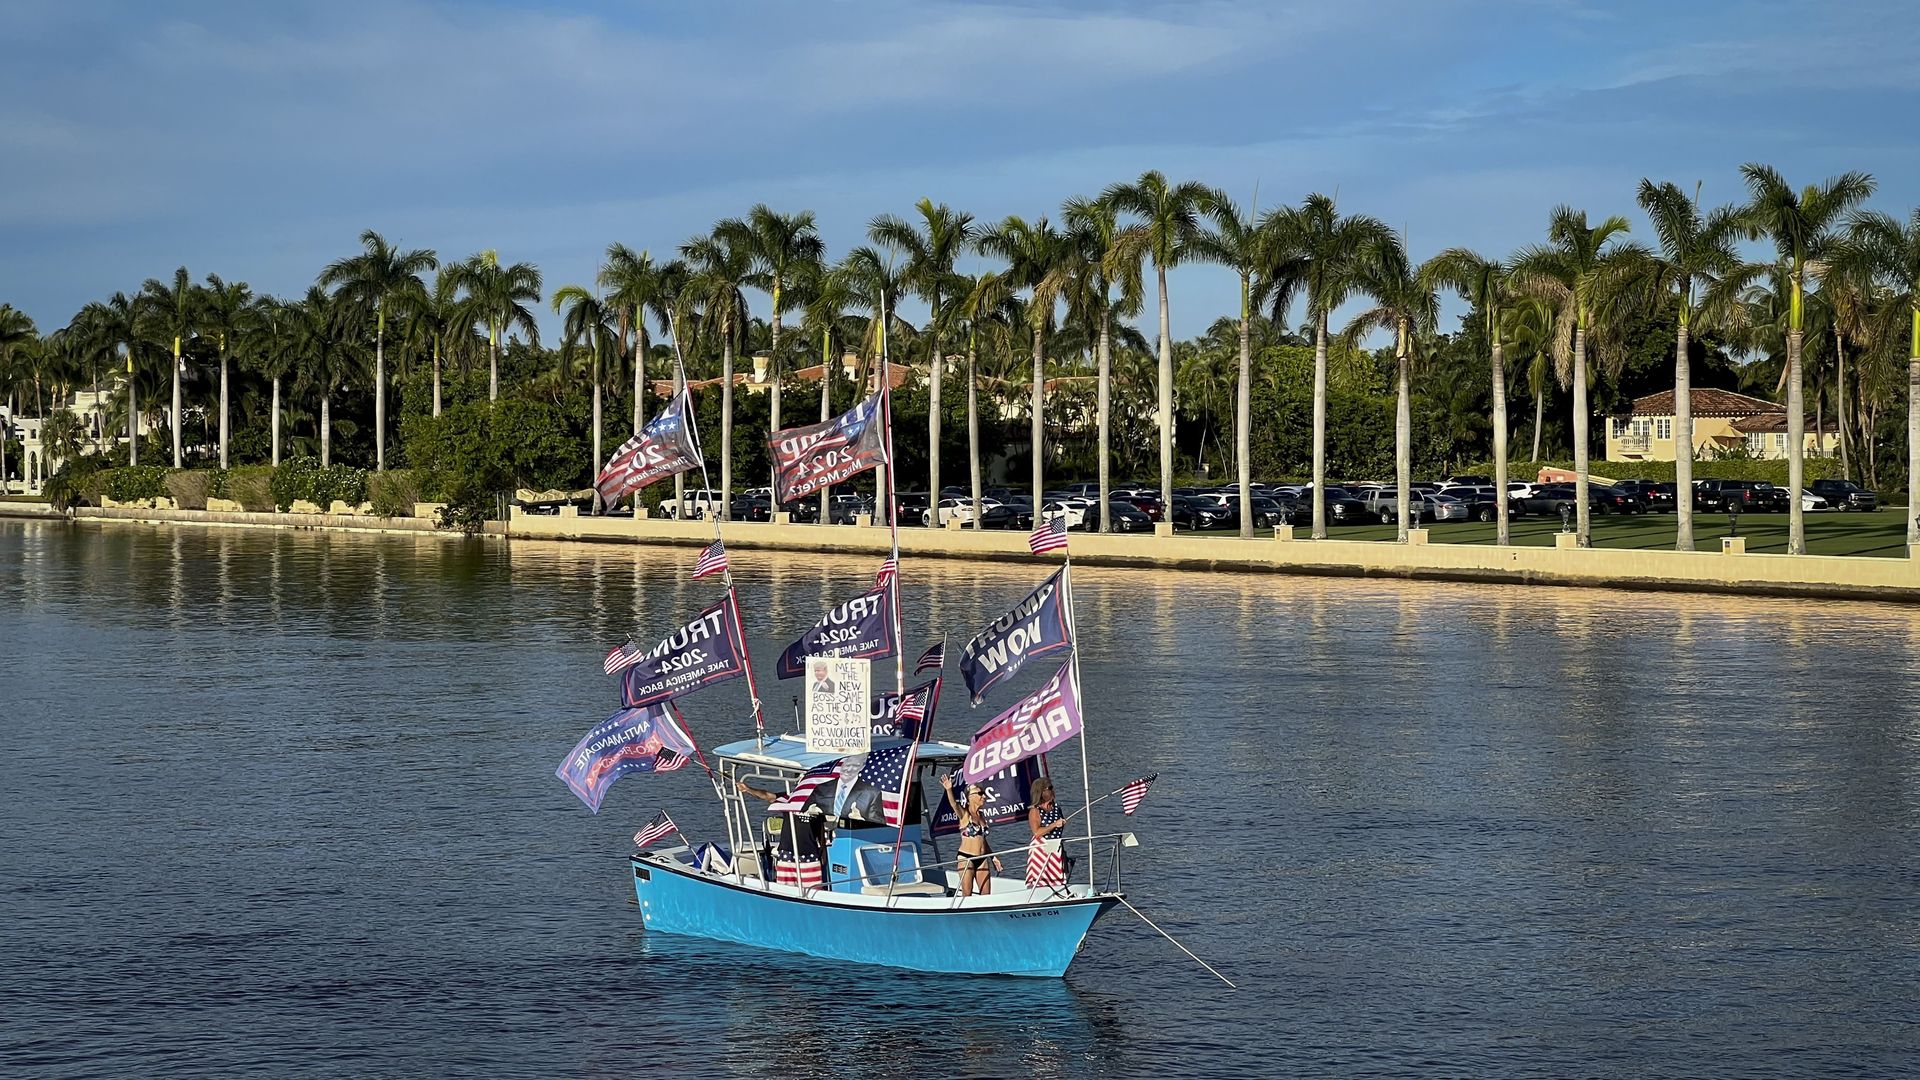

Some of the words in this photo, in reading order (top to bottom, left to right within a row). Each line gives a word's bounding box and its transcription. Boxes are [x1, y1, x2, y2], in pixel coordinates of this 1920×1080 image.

[977, 616, 1042, 674] WON
[835, 662, 866, 673] MEET
[841, 672, 859, 681] THE
[839, 681, 861, 691] NEW
[838, 690, 864, 704] SAME
[811, 703, 824, 713] AS
[826, 703, 841, 713] THE
[842, 703, 862, 713] OLD
[811, 727, 825, 738] WE
[849, 726, 866, 738] GET
[812, 738, 844, 748] FOOLED
